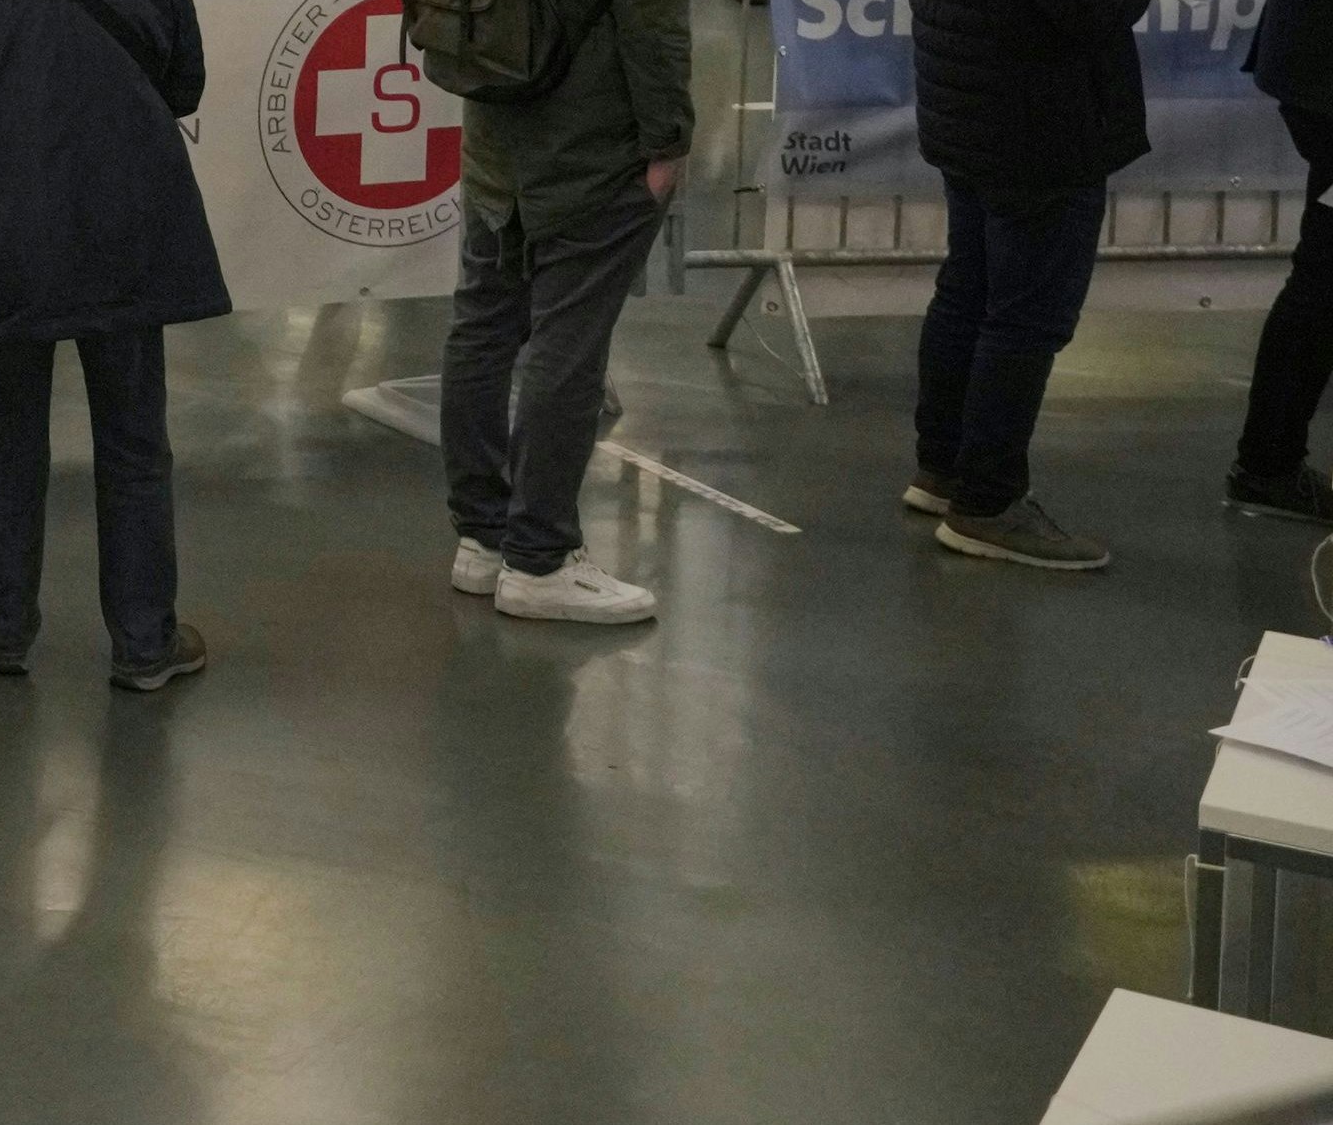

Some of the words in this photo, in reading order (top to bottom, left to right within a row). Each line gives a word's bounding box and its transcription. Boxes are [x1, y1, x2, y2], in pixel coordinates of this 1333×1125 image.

[267, 4, 328, 153] ARBEITER
[371, 62, 421, 134] S
[780, 154, 847, 175] Wien
[783, 131, 853, 152] Stadt
[300, 187, 462, 238] ÖSTERREIC
